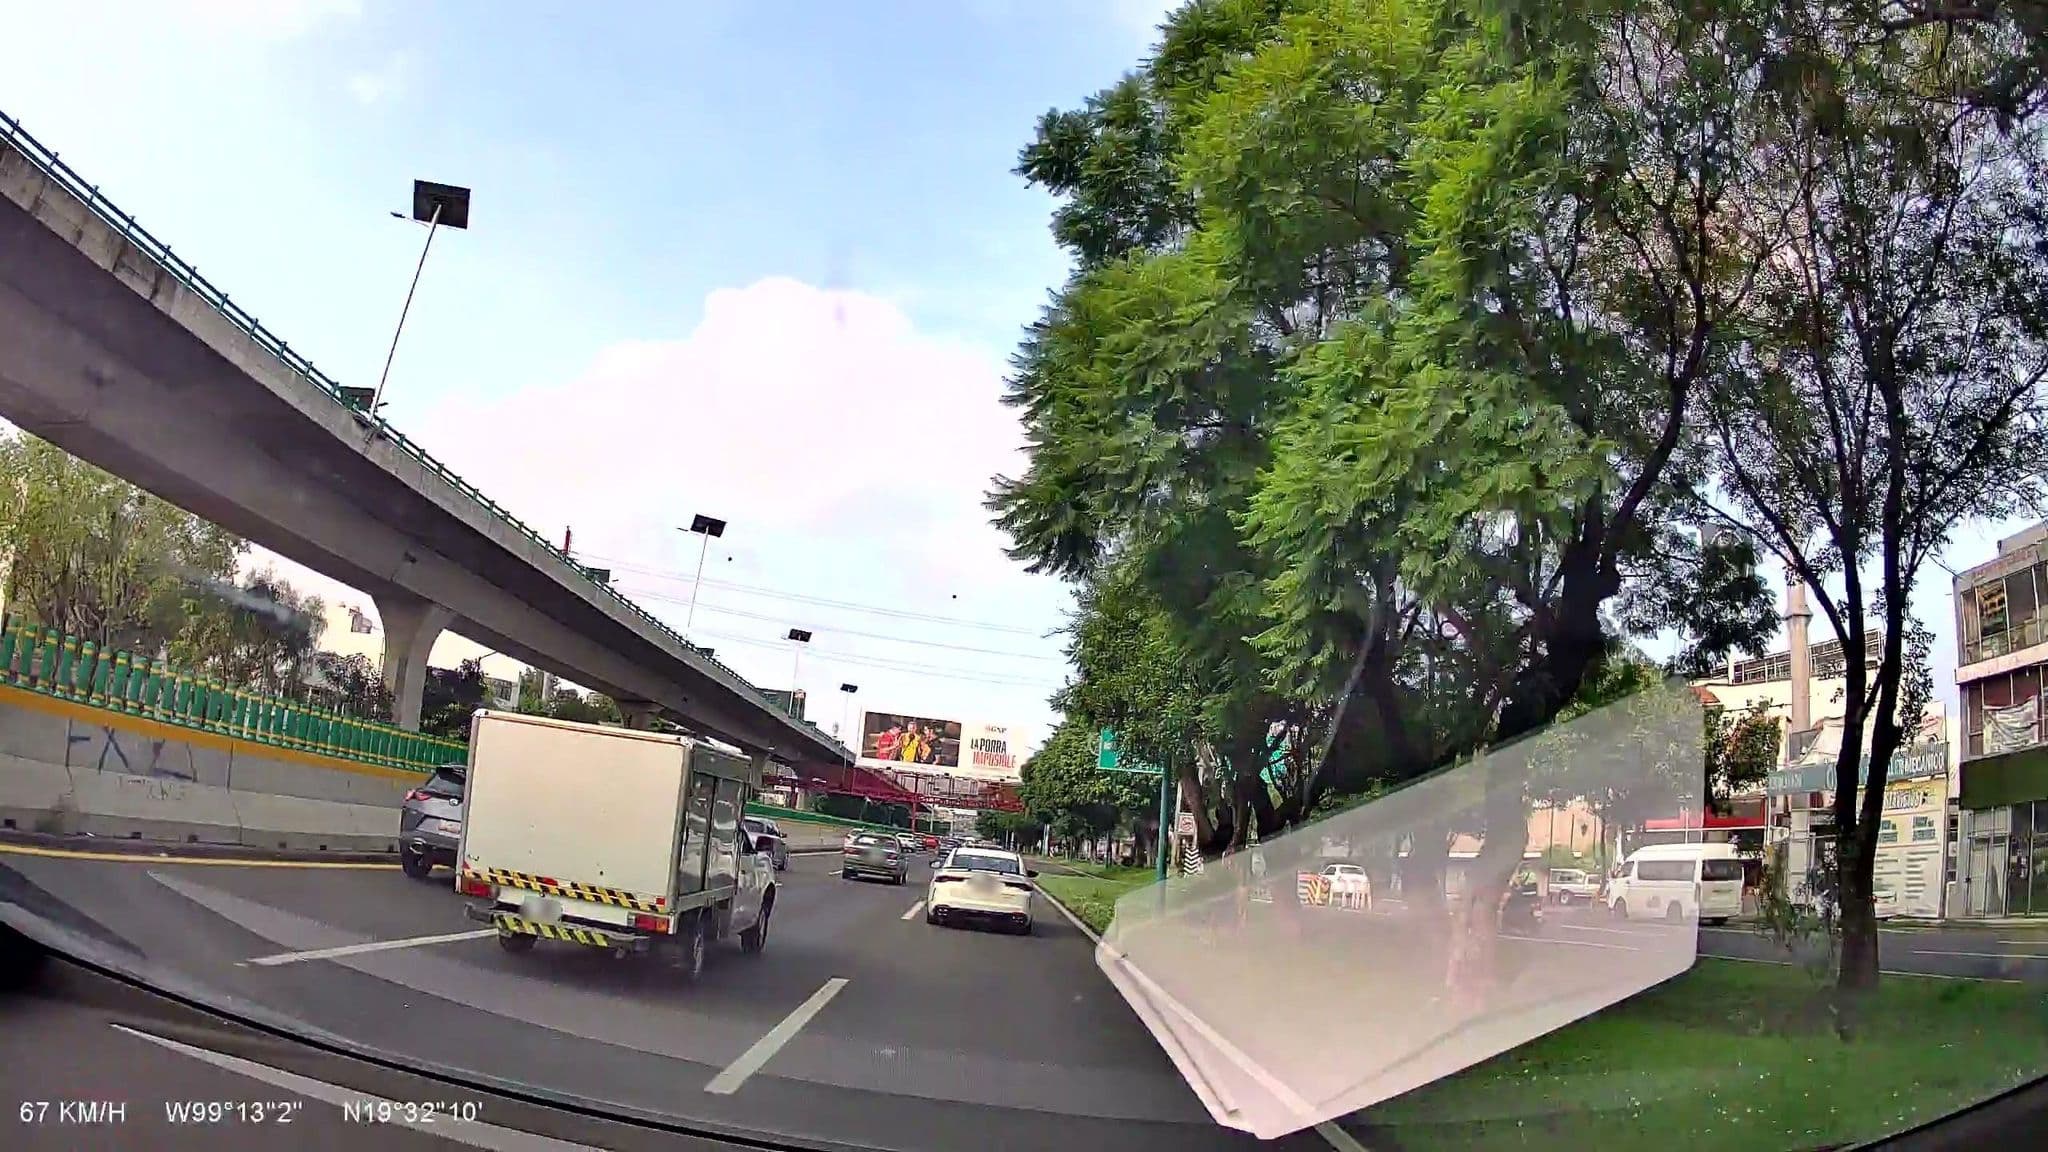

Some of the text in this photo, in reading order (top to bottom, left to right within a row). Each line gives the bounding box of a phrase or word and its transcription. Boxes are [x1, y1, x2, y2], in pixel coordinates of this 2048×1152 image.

[970, 737, 1007, 754] LA PORRA
[973, 751, 1016, 769] IMPOSIBLE
